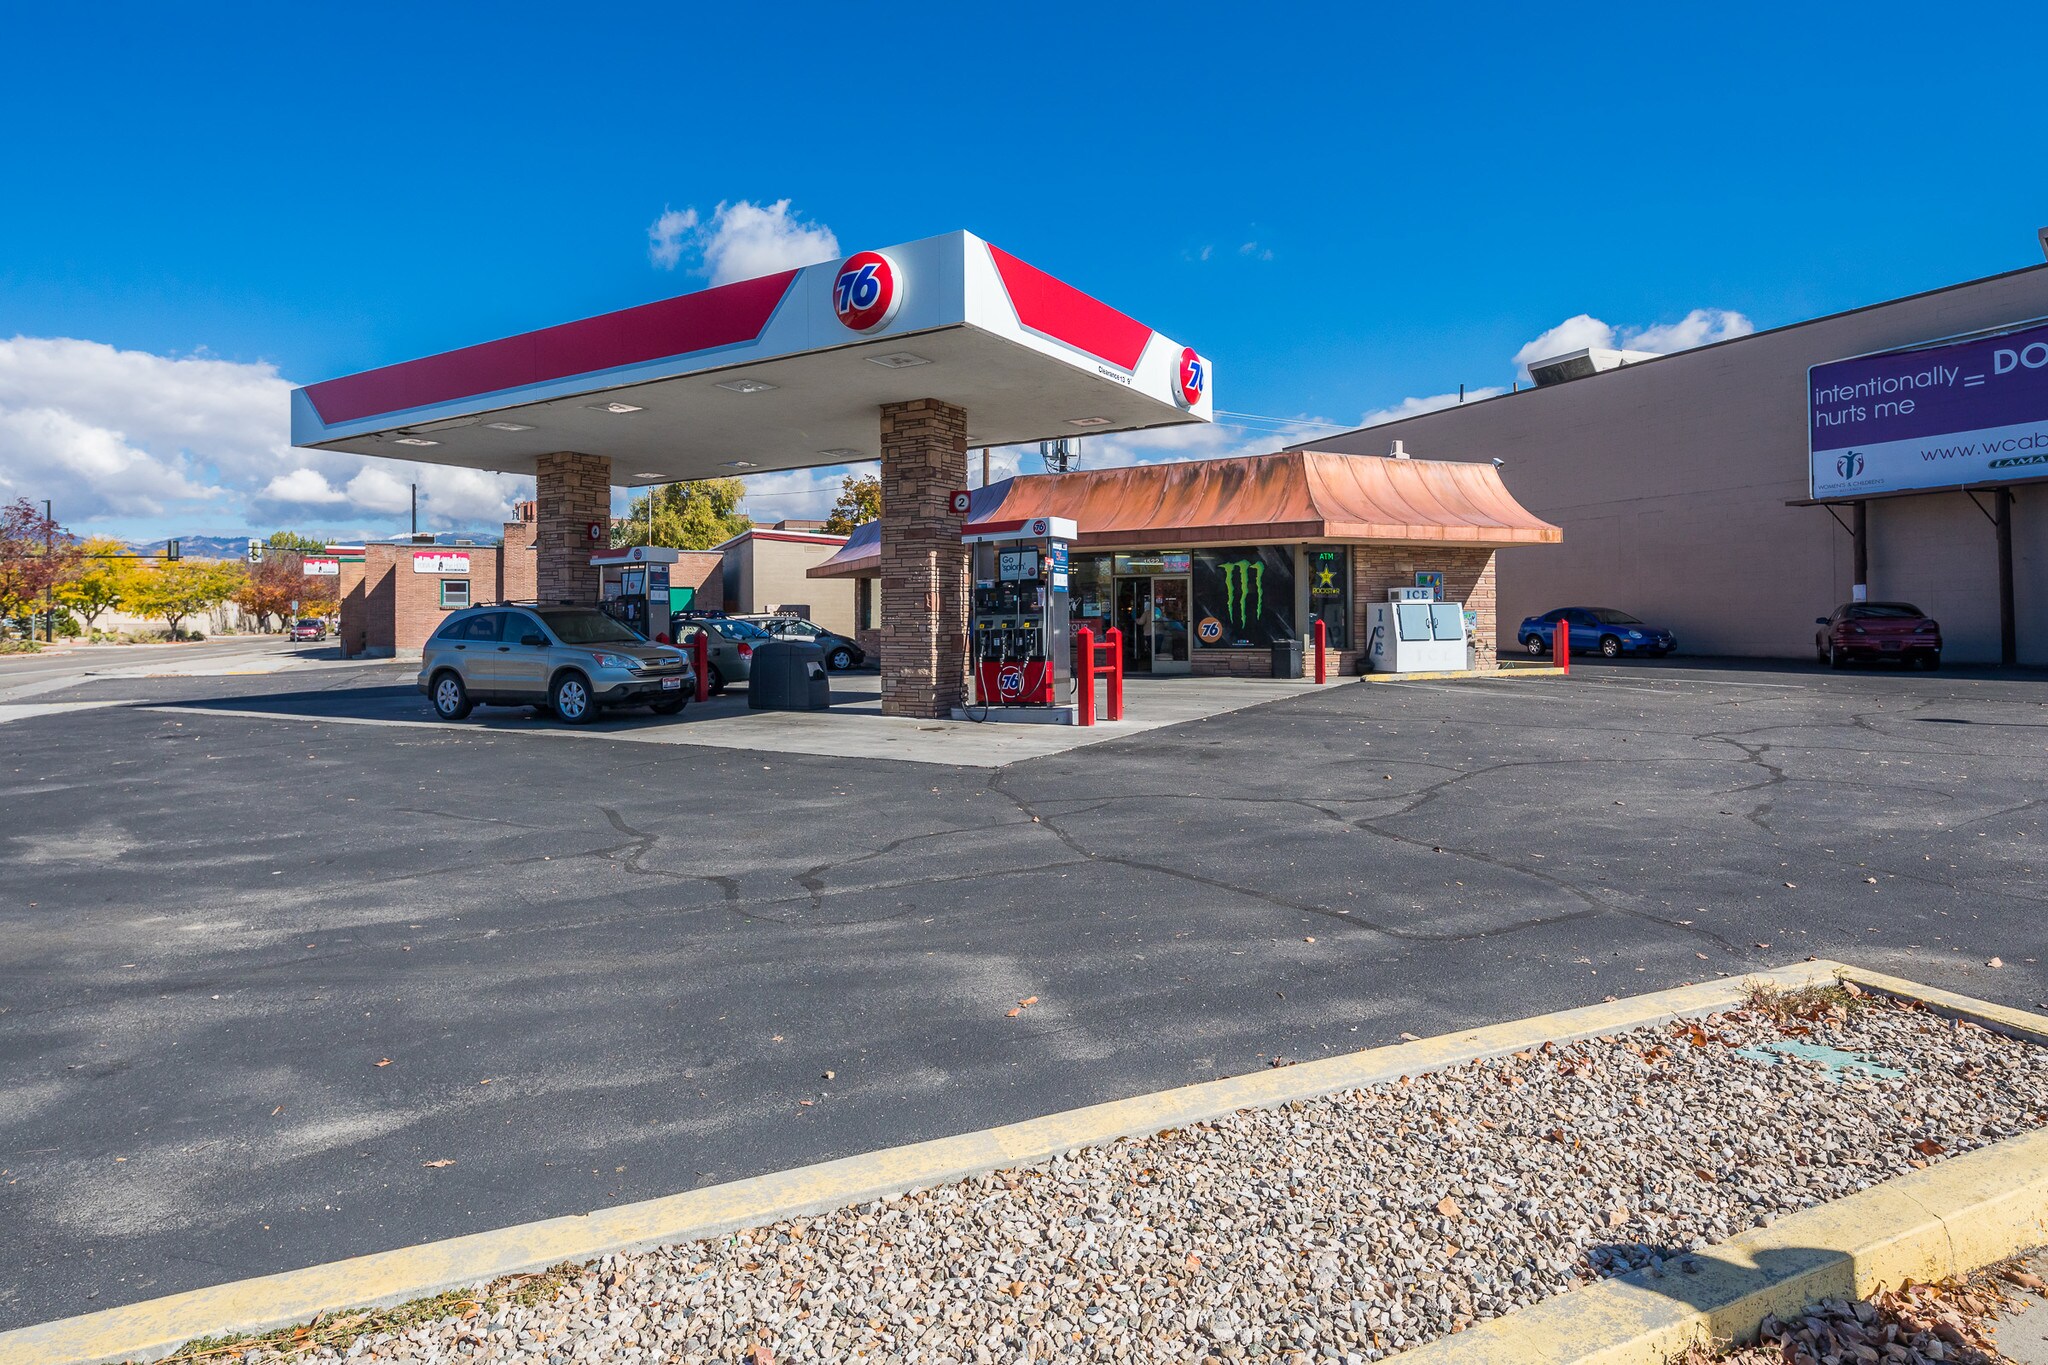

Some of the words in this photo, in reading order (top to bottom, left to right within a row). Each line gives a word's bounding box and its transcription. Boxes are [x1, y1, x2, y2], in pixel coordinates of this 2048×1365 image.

[836, 263, 882, 315] 76
[1098, 366, 1120, 381] Clearance
[1815, 365, 1959, 405] intentionally
[1993, 342, 2048, 375] DO
[1816, 405, 1866, 427] hurts
[1874, 399, 1915, 419] me
[1921, 432, 2048, 461] www.wcab
[958, 498, 965, 507] 2
[1034, 522, 1045, 533] 76
[1002, 556, 1014, 564] Go
[1406, 591, 1429, 599] ICE
[1202, 621, 1220, 637] 76
[1375, 609, 1385, 656] ICE
[1001, 673, 1020, 689] 76
